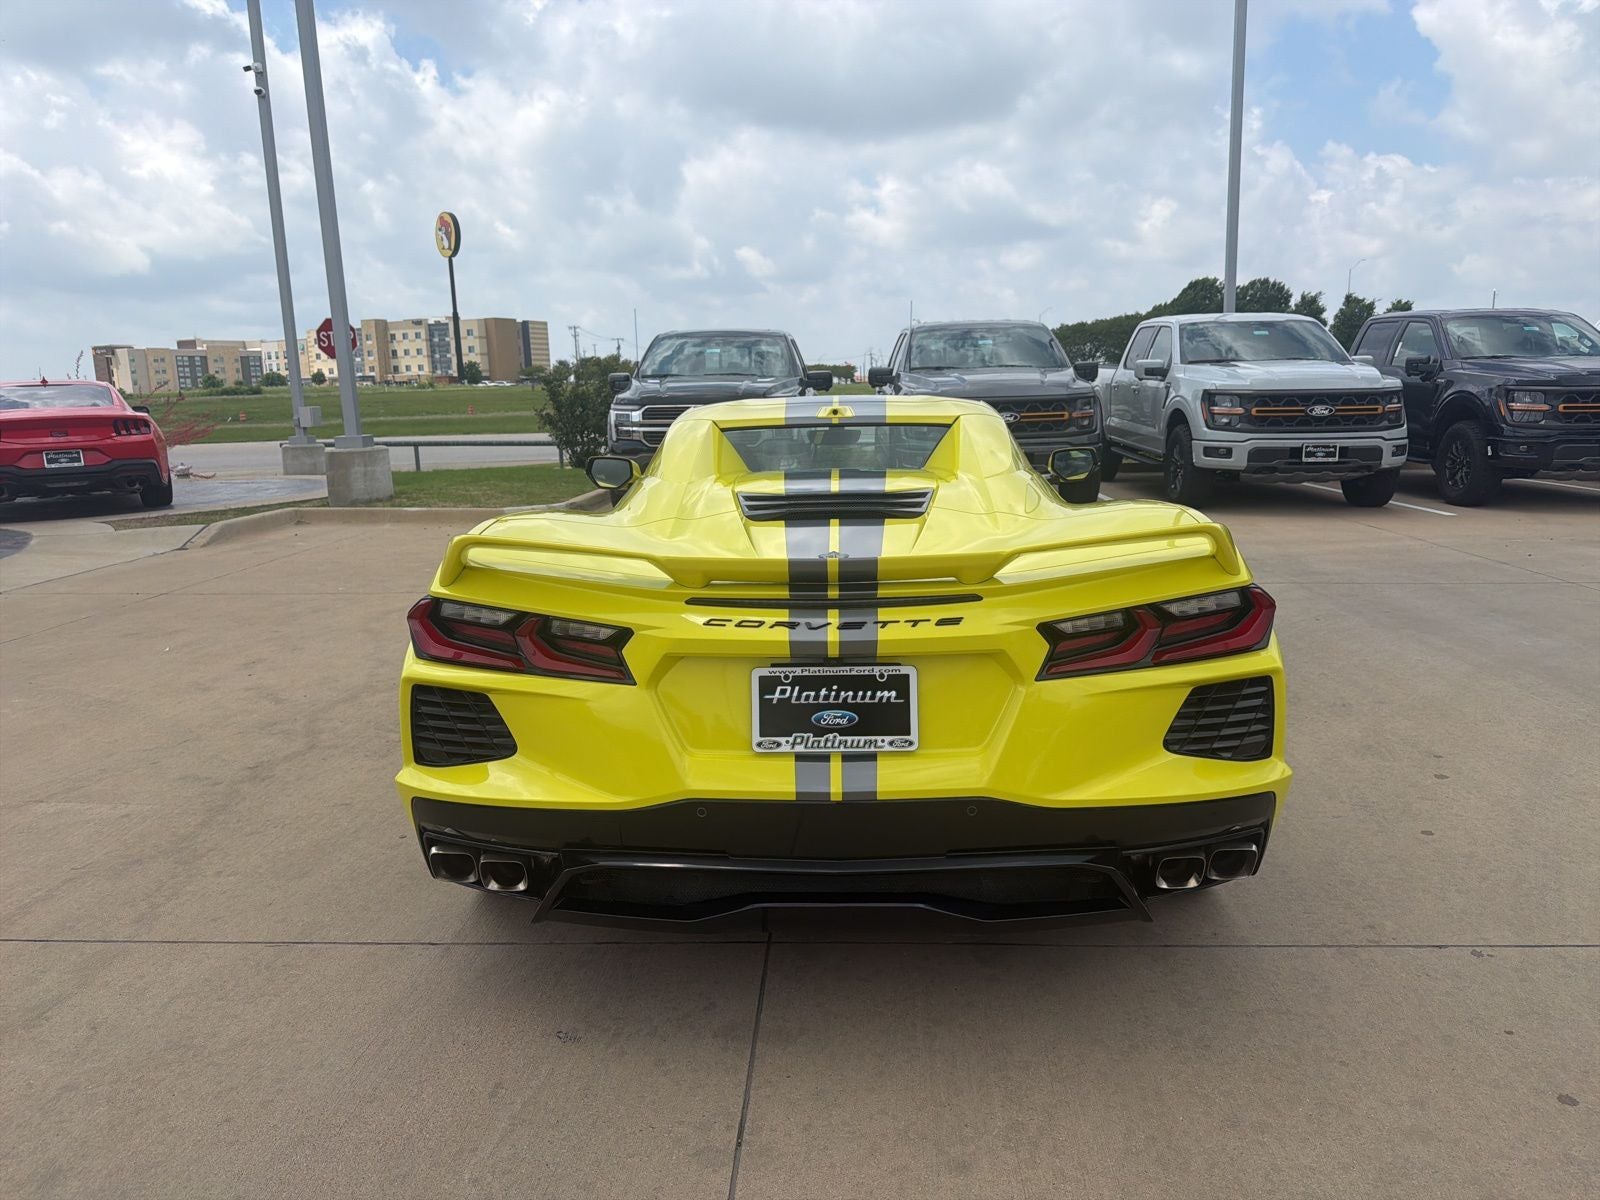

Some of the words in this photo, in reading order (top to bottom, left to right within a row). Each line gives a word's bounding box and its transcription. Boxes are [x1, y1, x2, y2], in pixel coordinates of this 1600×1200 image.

[320, 331, 354, 347] ST
[702, 616, 965, 631] CORVETTE
[768, 667, 901, 675] www.PlatinumFord.com
[763, 684, 905, 704] Platinum
[820, 712, 849, 725] Ford
[760, 739, 778, 750] Ford
[787, 733, 885, 750] Platinum
[892, 739, 910, 749] Ford
